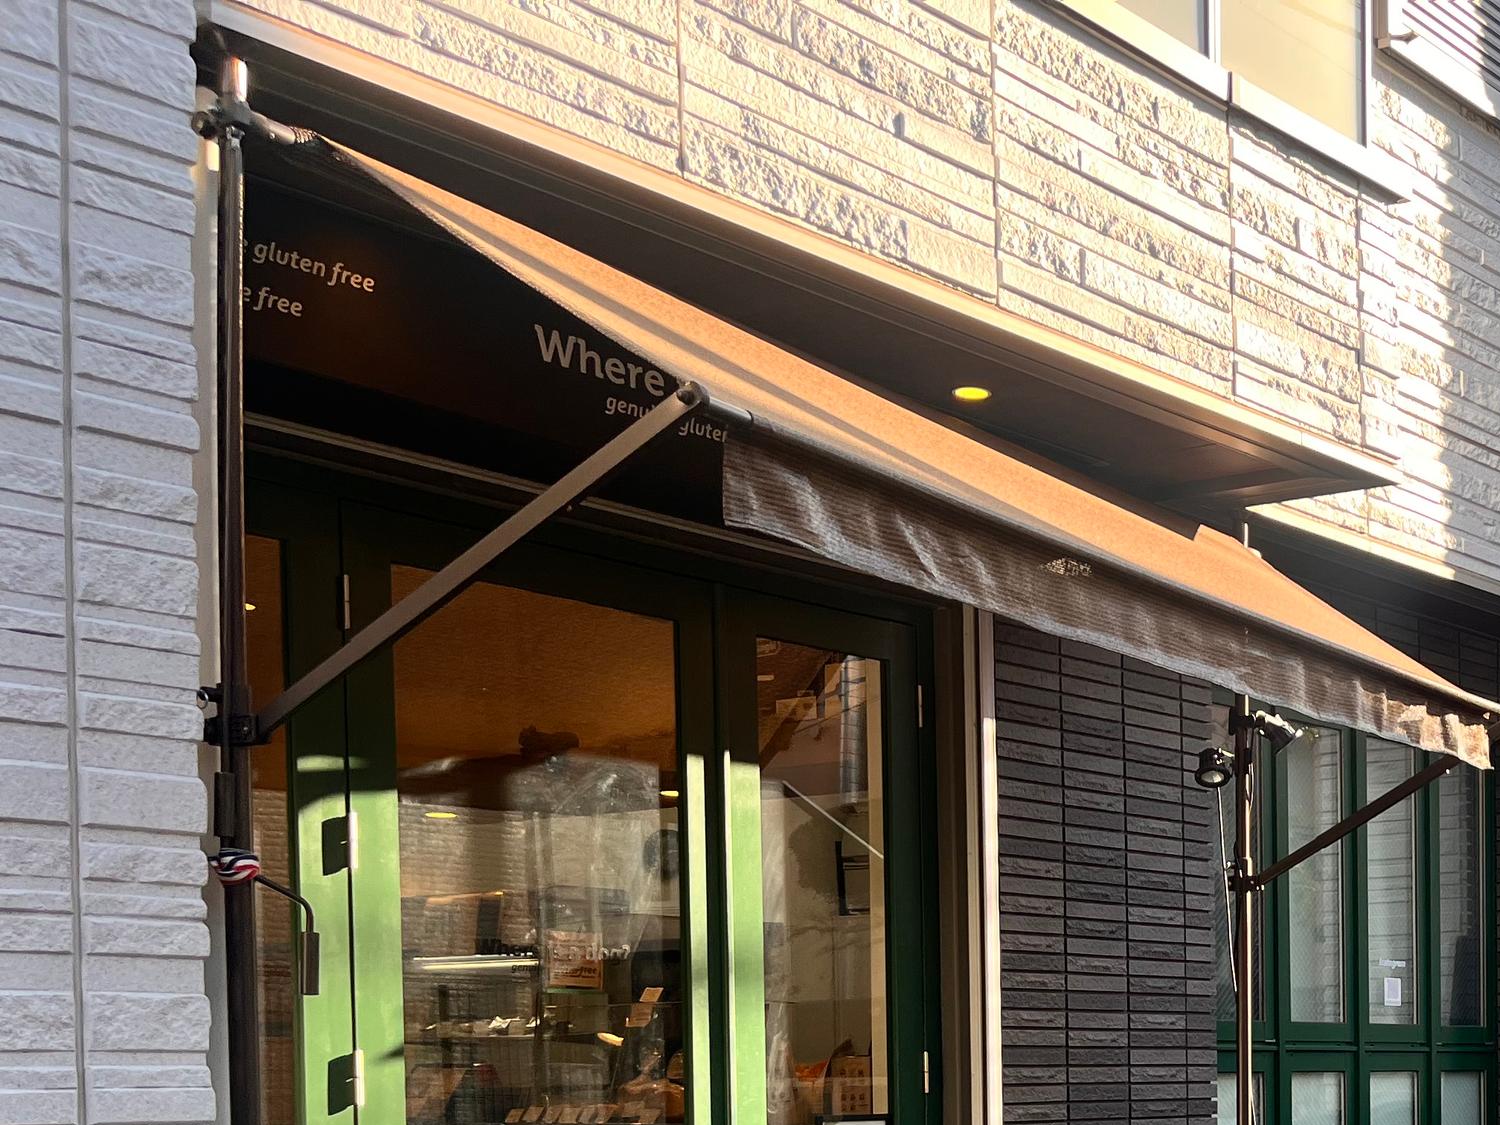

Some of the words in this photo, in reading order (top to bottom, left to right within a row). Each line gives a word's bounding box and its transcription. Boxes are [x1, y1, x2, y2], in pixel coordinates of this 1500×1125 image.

[252, 242, 326, 277] gluten
[327, 262, 375, 292] free
[253, 287, 303, 317] free
[534, 323, 665, 397] Where
